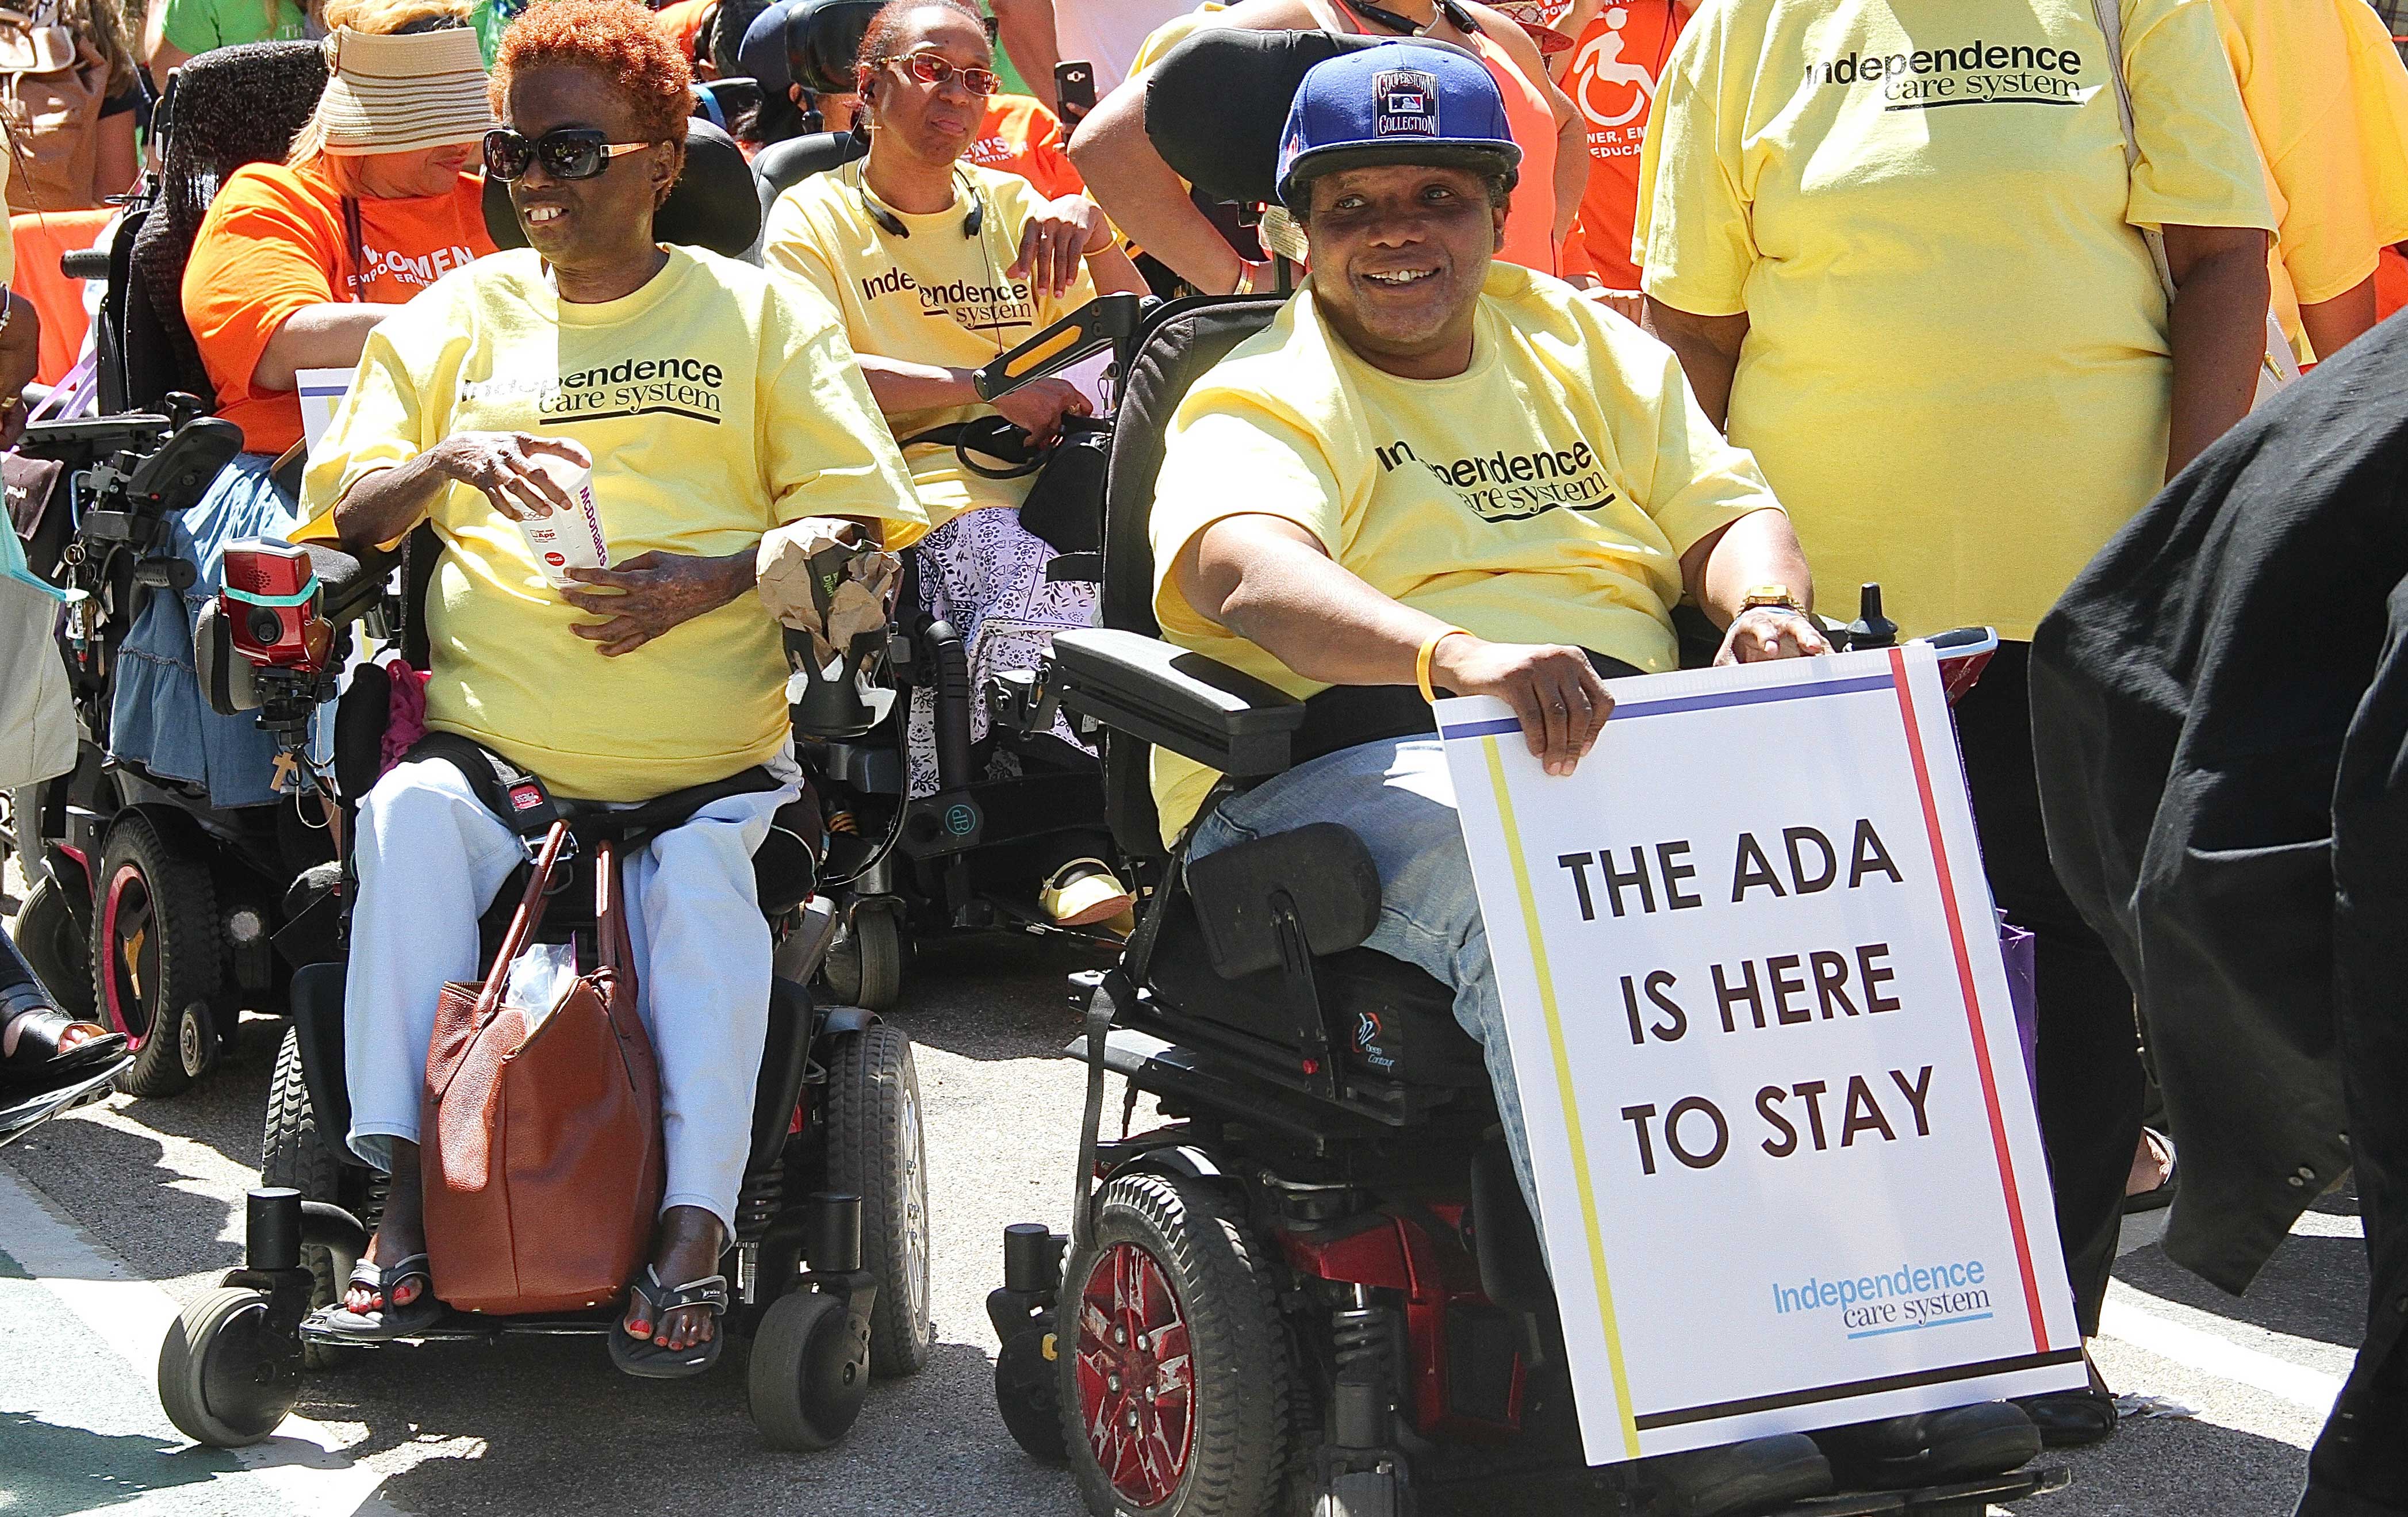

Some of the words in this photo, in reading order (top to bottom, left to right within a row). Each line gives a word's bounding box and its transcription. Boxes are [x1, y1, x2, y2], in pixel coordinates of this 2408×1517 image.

[1378, 72, 1436, 99] COOPERSTOWN
[1885, 75, 1955, 100] care
[1966, 71, 2080, 102] system
[1379, 115, 1435, 135] COLLECTION
[956, 303, 1032, 328] system
[539, 390, 605, 413] care
[615, 380, 722, 413] system
[1375, 440, 1592, 487] Inpendence
[1507, 471, 1609, 512] system
[1558, 840, 1703, 921] THE
[1731, 818, 1904, 903] ADA
[1620, 970, 1687, 1045] IS
[1710, 943, 1901, 1033] HERE
[1621, 1096, 1729, 1175] TO
[1755, 1065, 1932, 1158] STAY
[1772, 1261, 1985, 1313] Independence
[1843, 1302, 1897, 1328] care
[1903, 1289, 1991, 1327] system
